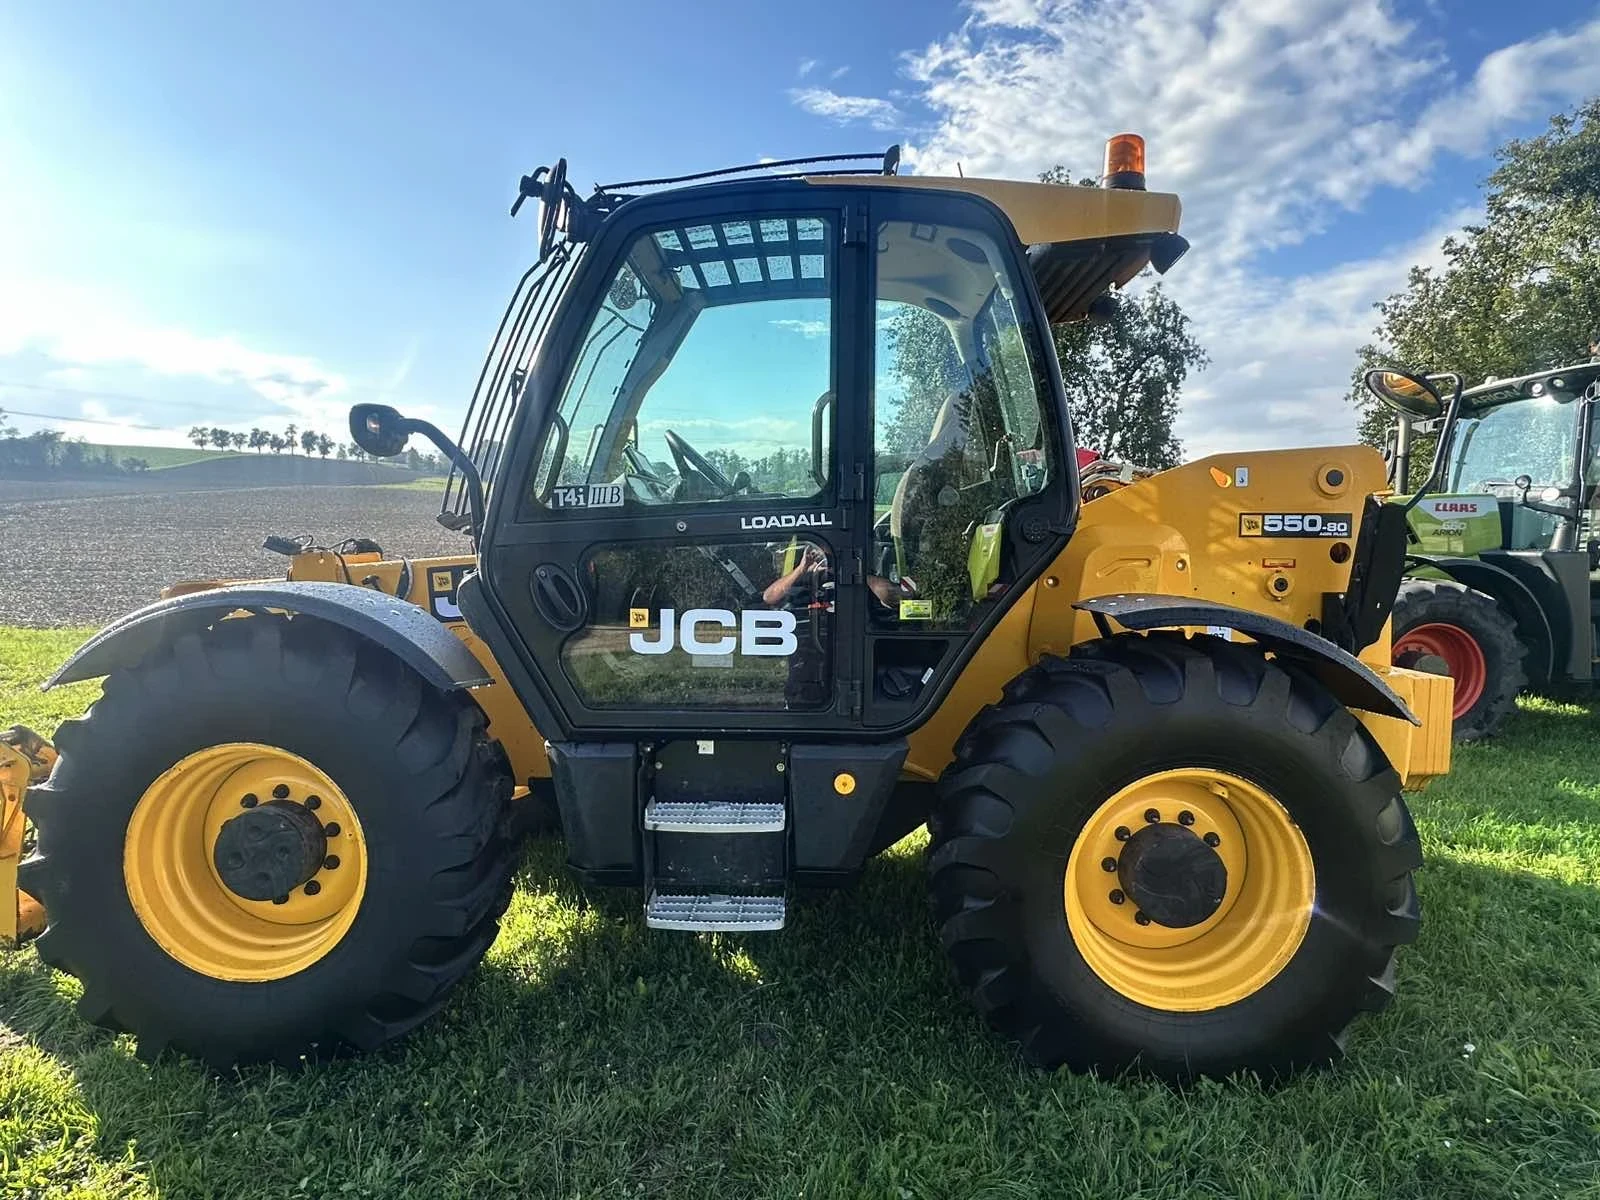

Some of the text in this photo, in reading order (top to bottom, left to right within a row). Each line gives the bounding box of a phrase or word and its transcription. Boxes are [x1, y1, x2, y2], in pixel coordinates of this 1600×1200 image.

[553, 487, 586, 507] T4i
[1435, 503, 1477, 513] CLAAS
[740, 512, 833, 530] LOADALL
[1432, 529, 1463, 537] ARION
[629, 608, 798, 656] JCB
